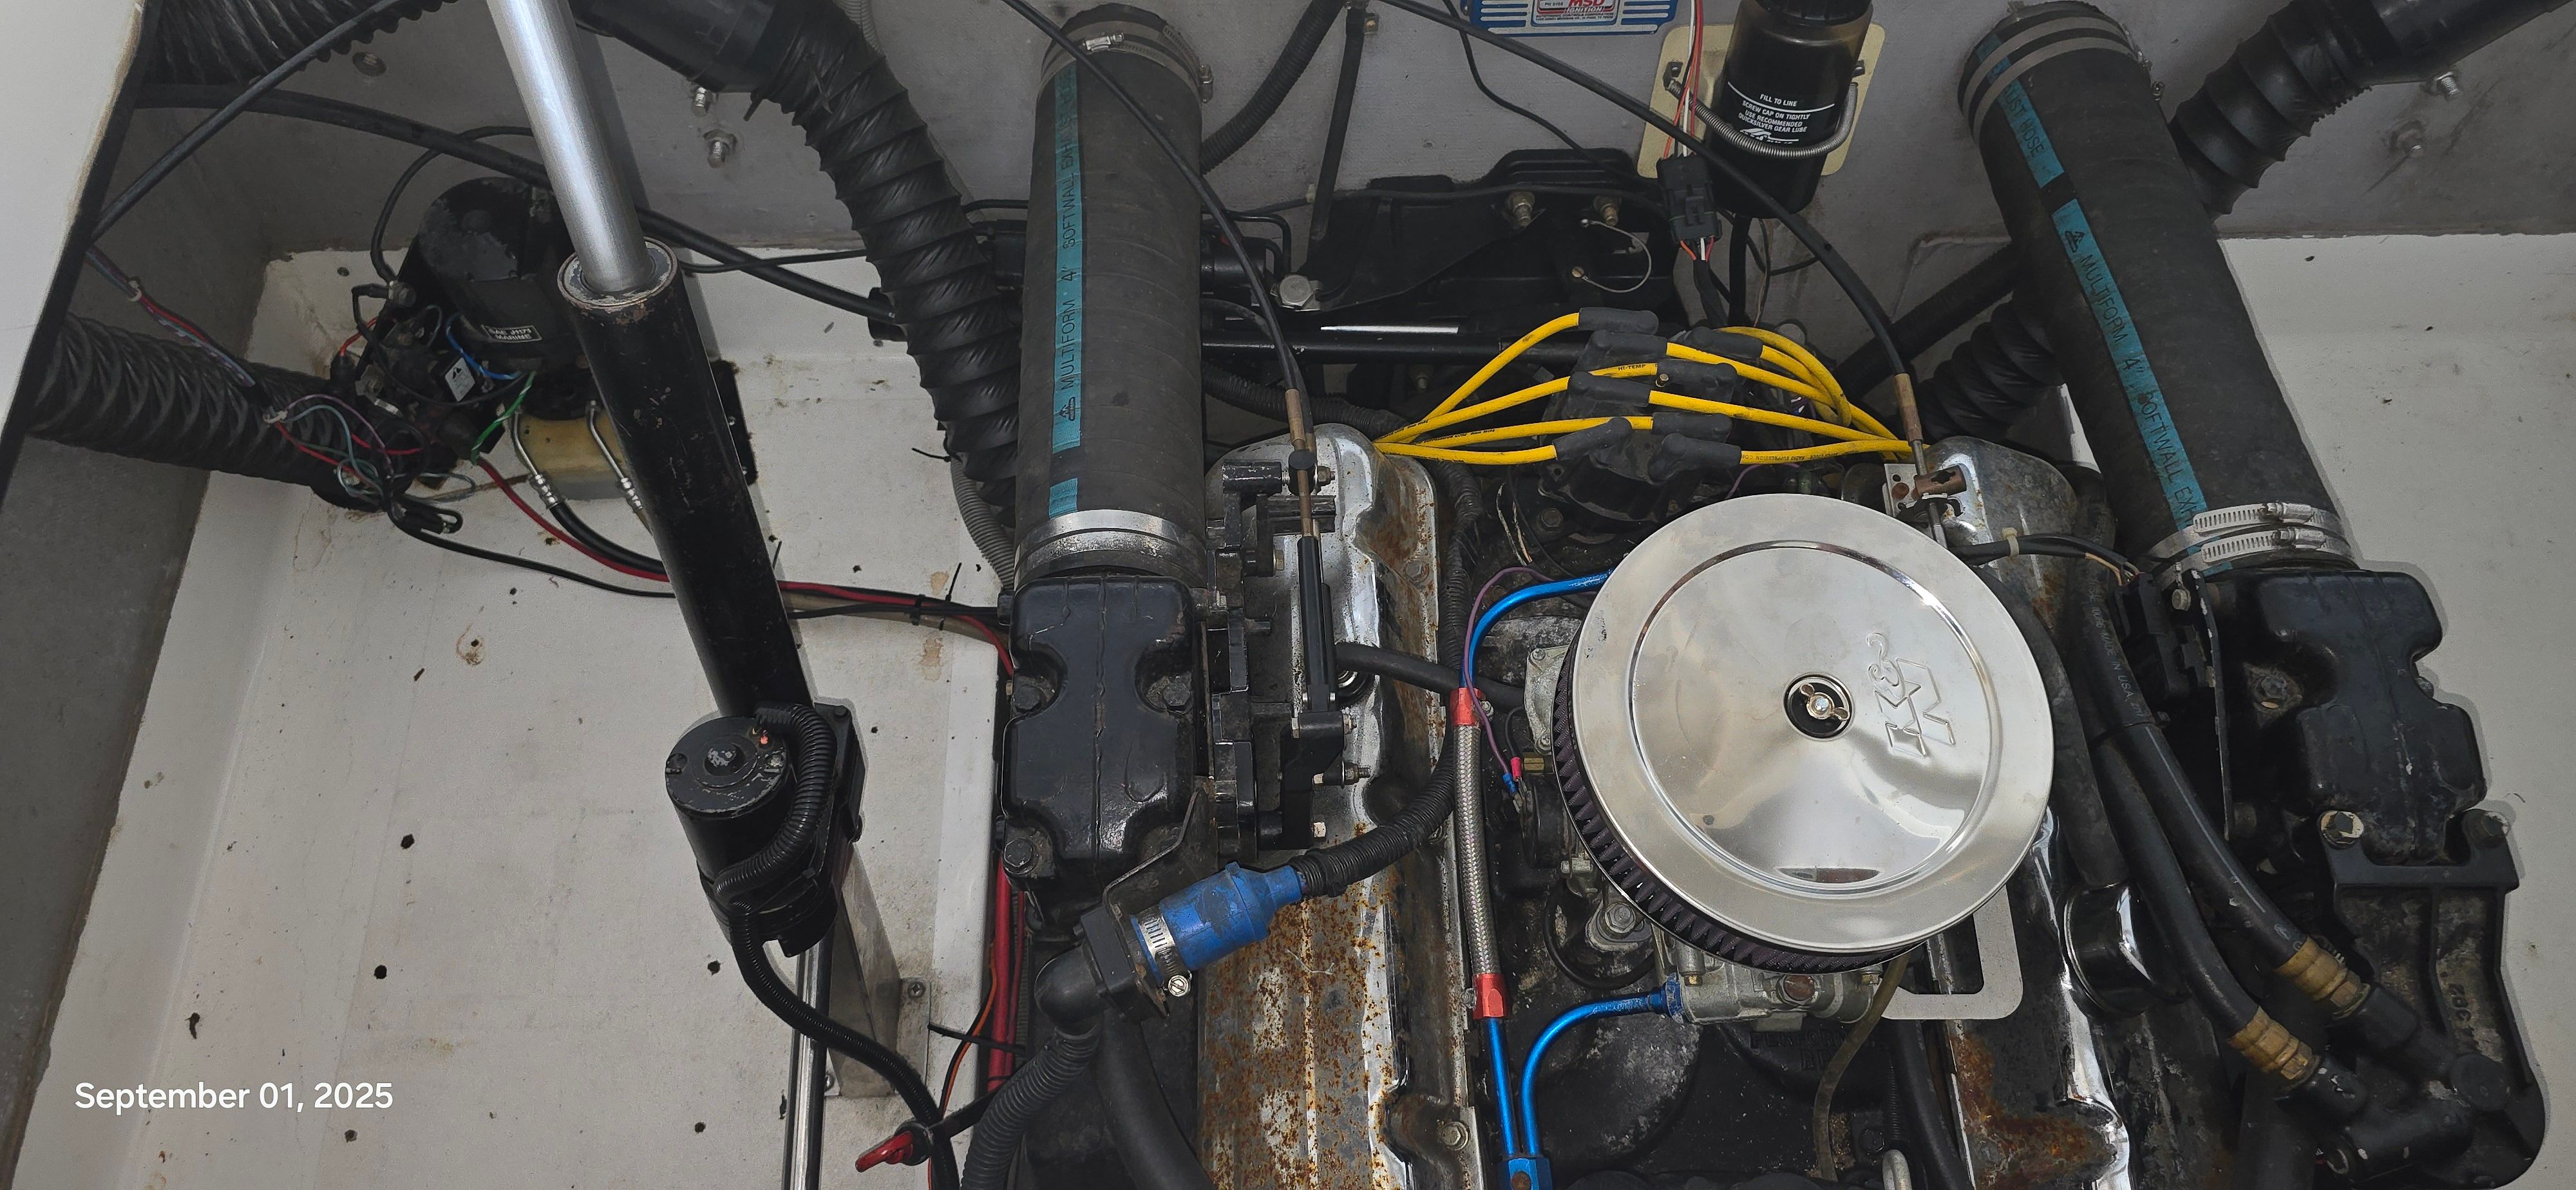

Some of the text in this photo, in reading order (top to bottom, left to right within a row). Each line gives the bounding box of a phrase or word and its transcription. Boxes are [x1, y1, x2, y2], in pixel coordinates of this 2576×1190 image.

[1742, 100, 1761, 113] SCREW
[1745, 109, 1803, 127] USE RECOMMENDED
[1759, 94, 1772, 103] FILL
[1738, 112, 1773, 130] QUICKSILVER
[2019, 118, 2045, 157] HOSE
[1062, 173, 1076, 249] SOFTWALL
[2080, 254, 2128, 343] MULTIFORM
[1060, 299, 1075, 390] MULTIFORM
[2100, 632, 2117, 656] MADE
[2112, 661, 2123, 671] IN
